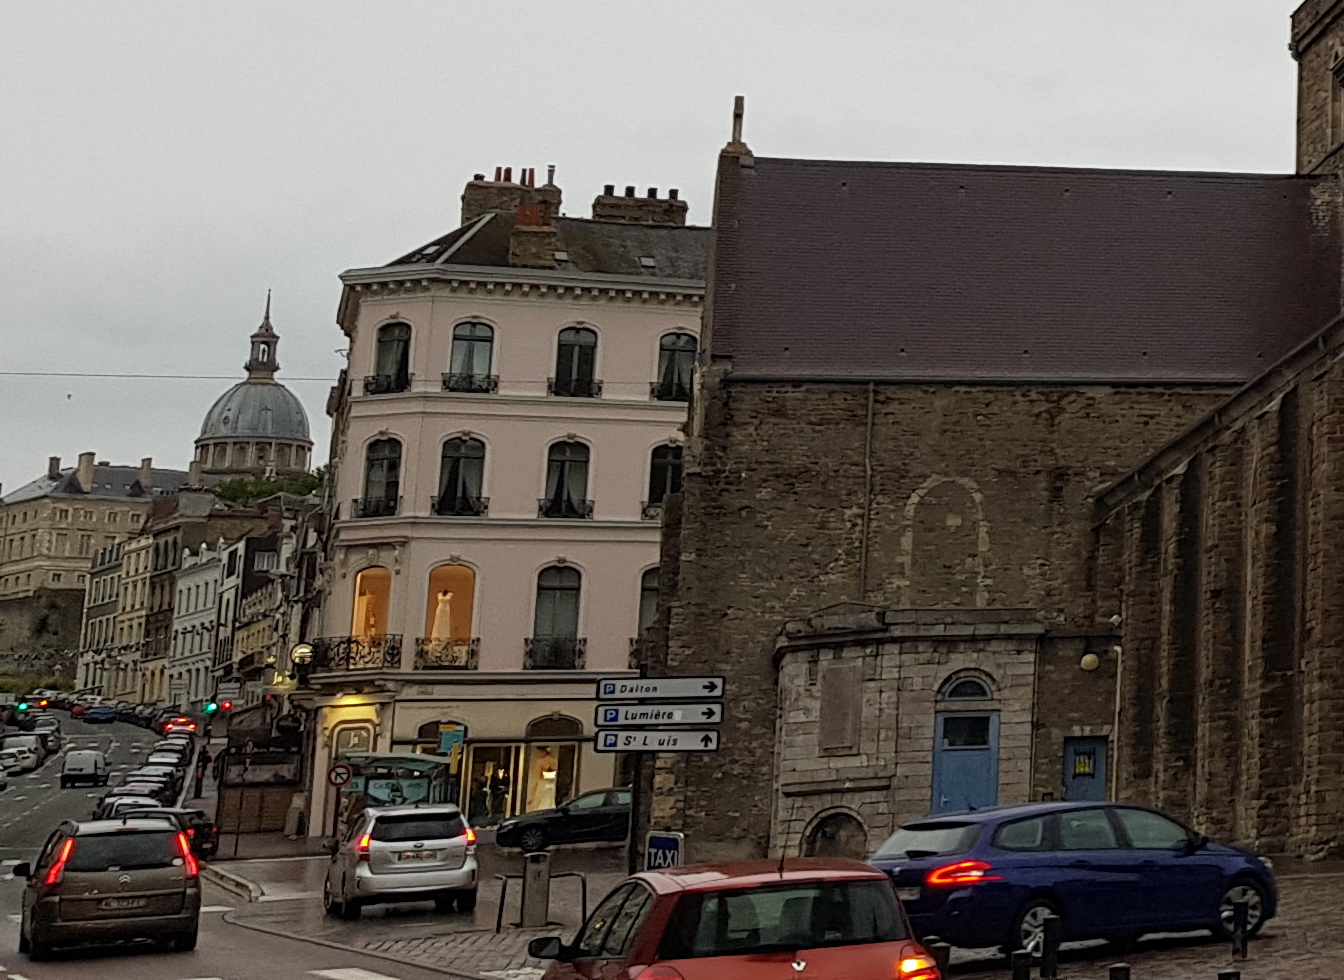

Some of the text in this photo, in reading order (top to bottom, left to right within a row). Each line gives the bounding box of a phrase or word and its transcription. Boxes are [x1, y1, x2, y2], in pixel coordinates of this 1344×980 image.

[620, 684, 658, 694] Dalton
[624, 709, 674, 721] Lumière
[648, 848, 678, 868] TAXI
